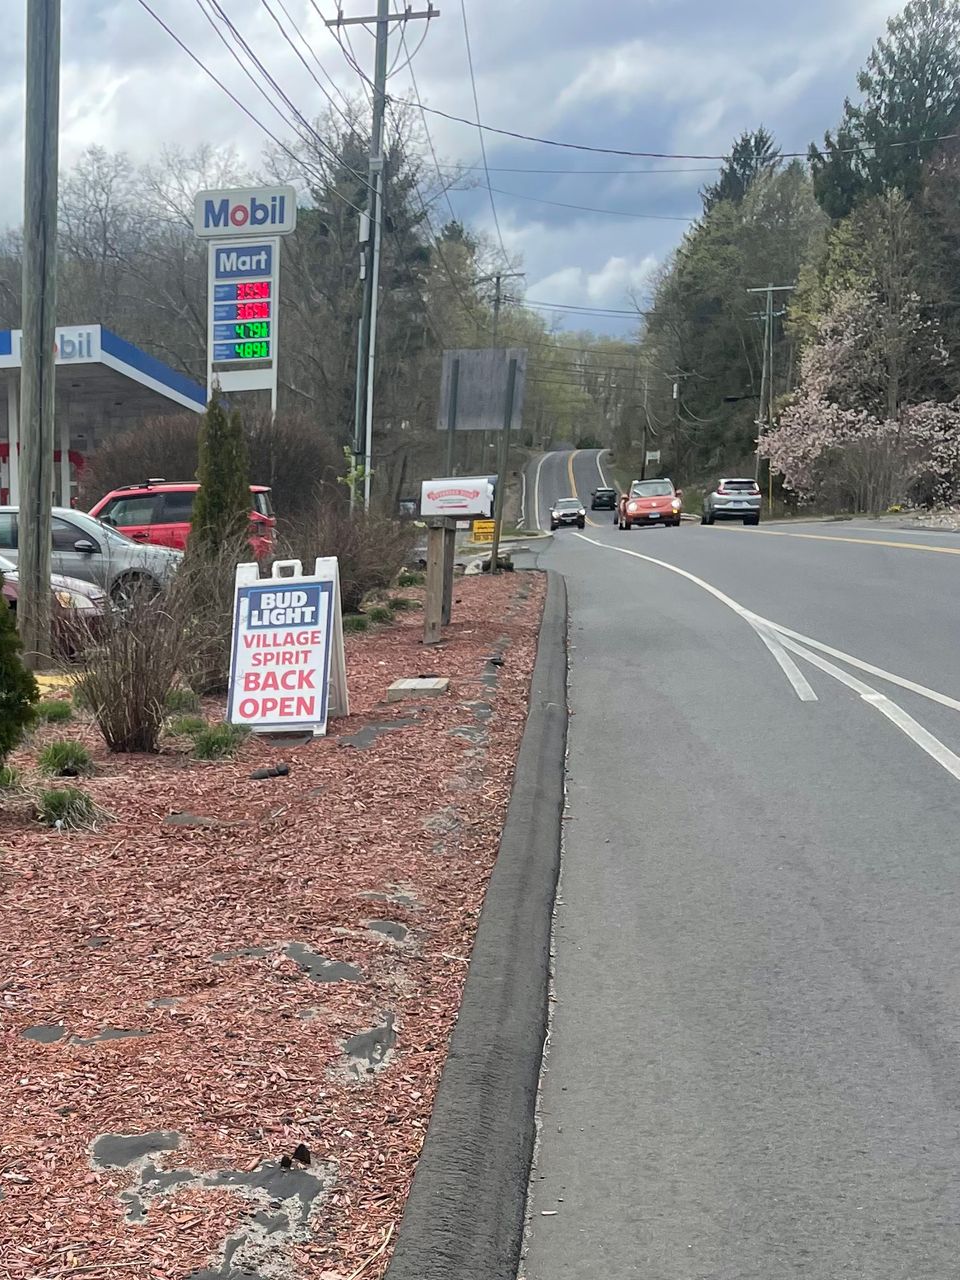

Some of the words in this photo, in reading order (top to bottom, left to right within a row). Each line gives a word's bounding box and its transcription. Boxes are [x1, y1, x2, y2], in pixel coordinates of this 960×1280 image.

[204, 195, 285, 228] Mobil
[219, 250, 268, 273] Mart
[52, 332, 92, 360] bil
[260, 591, 308, 609] BUD
[250, 606, 316, 626] LIGHT
[243, 630, 321, 649] VILLAGE
[251, 650, 312, 667] SPIRIT
[243, 669, 317, 692] BACK
[239, 696, 316, 719] OPEN
